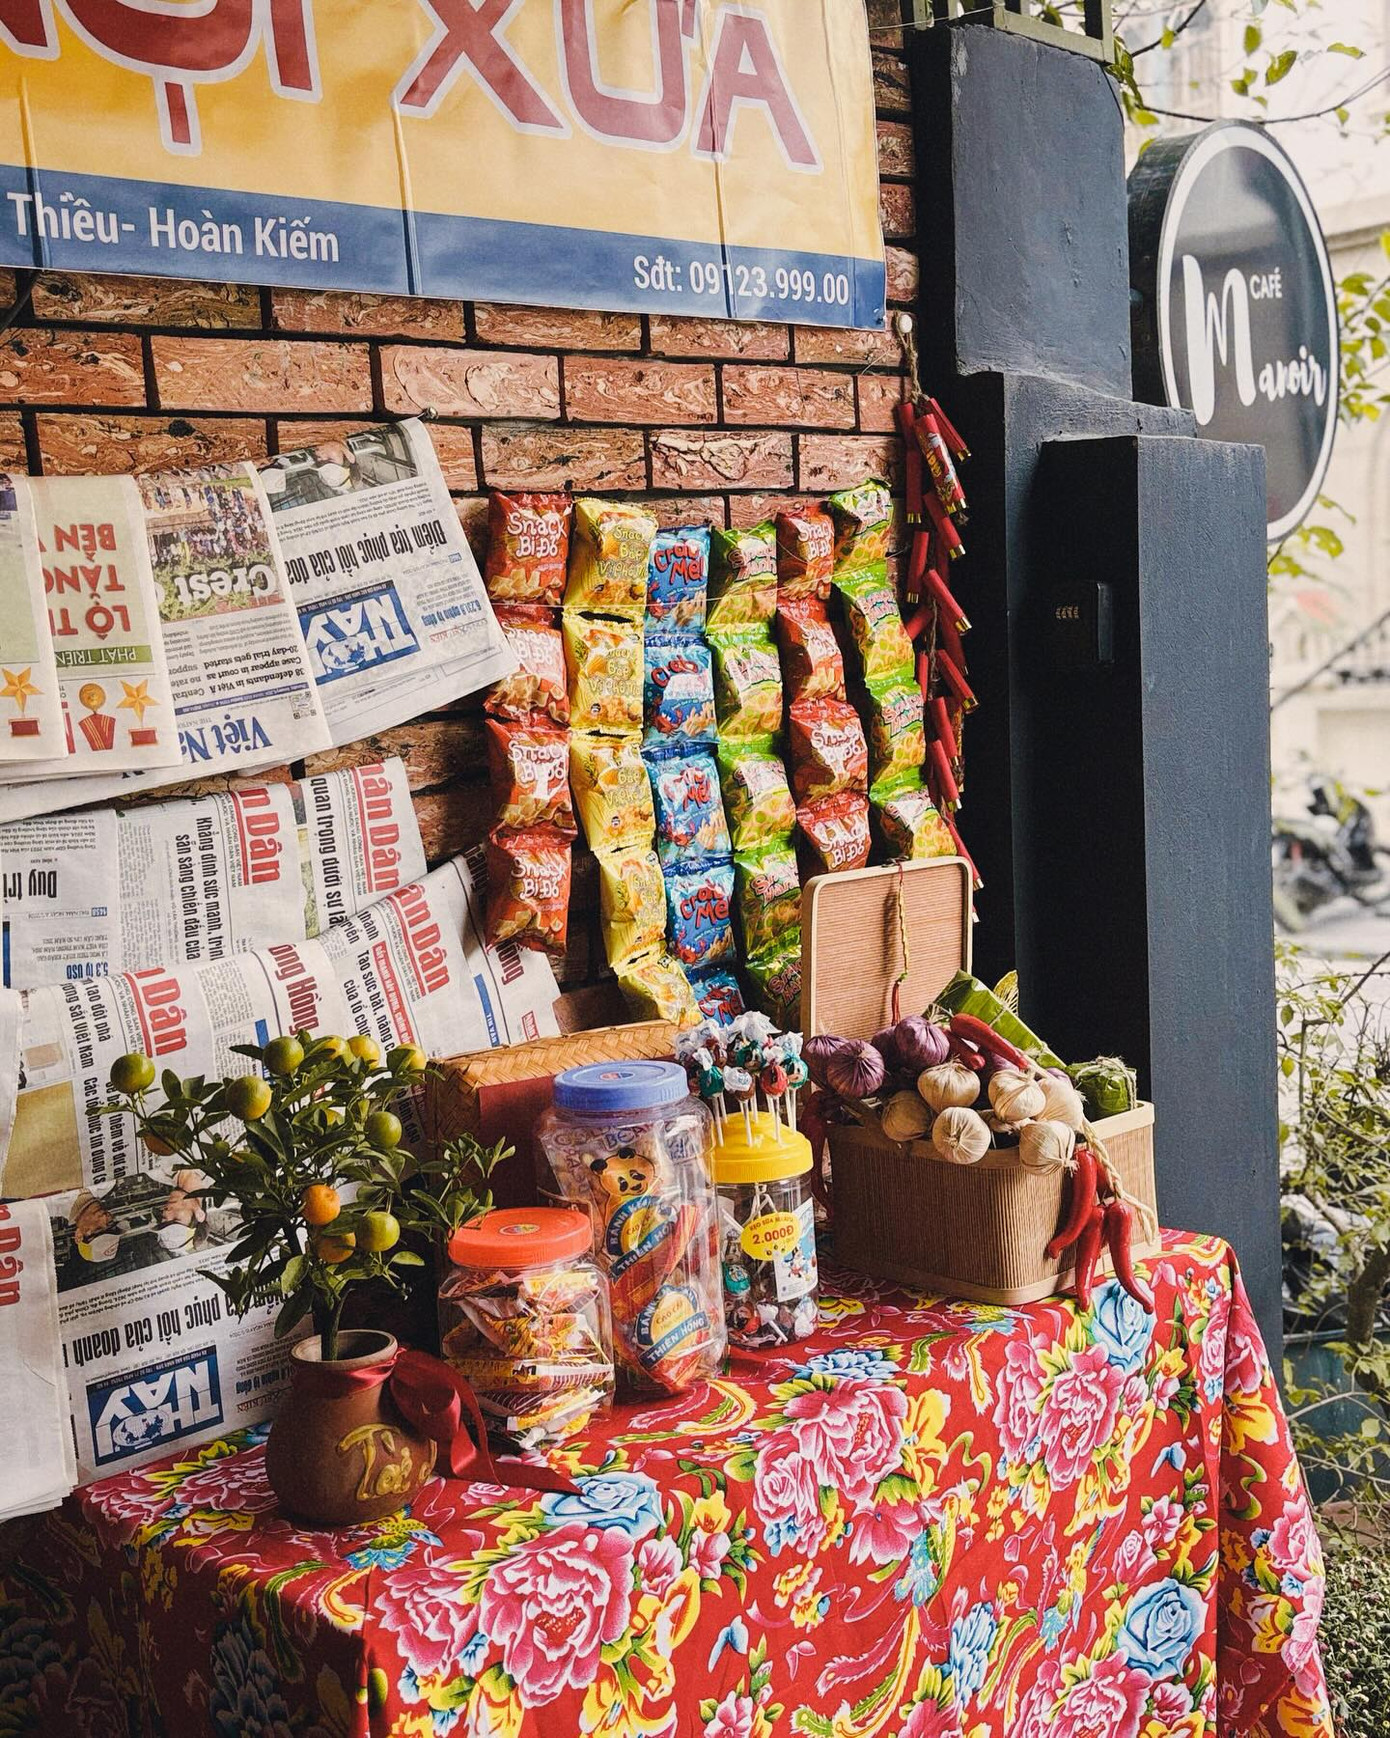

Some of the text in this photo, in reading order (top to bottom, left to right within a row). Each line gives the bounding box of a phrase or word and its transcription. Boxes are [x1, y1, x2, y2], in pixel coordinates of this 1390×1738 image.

[149, 207, 244, 255] Hoàn
[255, 215, 340, 263] Kiếm
[633, 254, 683, 293] Sđt:
[1250, 267, 1283, 300] CAFÉ
[1182, 254, 1328, 426] Manoir
[390, 524, 412, 554] tựa
[412, 519, 448, 556] Điểm
[507, 512, 568, 540] Snack
[53, 522, 117, 565] BỀN
[356, 532, 390, 564] phục
[309, 549, 335, 582] của
[336, 543, 360, 578] hồi
[173, 561, 278, 610] Crest
[84, 599, 131, 641] LỘ
[306, 594, 406, 647] NAY
[99, 647, 136, 665] PHÁT
[203, 644, 299, 670] 20-day trial gets started
[206, 656, 302, 681] Case appear in court as
[190, 675, 201, 684] no
[216, 668, 304, 693] 38 defendants in Việt
[209, 707, 273, 760] Việt
[310, 777, 333, 812] quan
[195, 816, 221, 852] Khẳng
[245, 811, 284, 885] Dân
[312, 815, 338, 854] trọng
[197, 852, 220, 877] định
[369, 822, 403, 892] Dân
[3, 868, 58, 903] Duy trì
[175, 833, 208, 960] sẵn sàng chiến đấu của
[202, 879, 222, 899] sức
[322, 891, 344, 909] sự
[201, 901, 224, 935] mạnh,
[356, 909, 381, 943] thành
[66, 963, 83, 980] USD
[353, 950, 374, 972] Tạo
[411, 922, 451, 995] Dân
[82, 984, 102, 1004] tạo
[343, 978, 363, 1001] của
[361, 970, 381, 993] sức
[68, 1002, 90, 1022] sắt
[87, 1002, 109, 1022] đột
[120, 1000, 131, 1019] NHÂN
[141, 977, 189, 1057] Dân
[286, 976, 323, 1037] Hồng
[349, 999, 368, 1014] tổ
[366, 994, 387, 1016] bật,
[70, 1021, 92, 1045] Việt
[93, 1021, 114, 1043] phá
[374, 1014, 396, 1043] nâng
[76, 1044, 97, 1069] Nam
[83, 1077, 101, 1097] Các
[87, 1113, 105, 1134] hức
[108, 1113, 127, 1140] thêm
[88, 1148, 108, 1174] dụng
[108, 1152, 128, 1167] dự
[111, 1139, 130, 1153] về
[113, 1166, 129, 1179] án
[752, 1225, 795, 1245] 2.000Đ
[616, 1240, 652, 1270] THIÊN
[186, 1293, 222, 1331] phục
[125, 1322, 153, 1353] của
[158, 1317, 182, 1347] hồi
[646, 1315, 706, 1363] THIÊN HỒNG
[72, 1332, 115, 1368] doanh
[96, 1361, 210, 1427] NAY
[96, 1390, 220, 1456] THỜI
